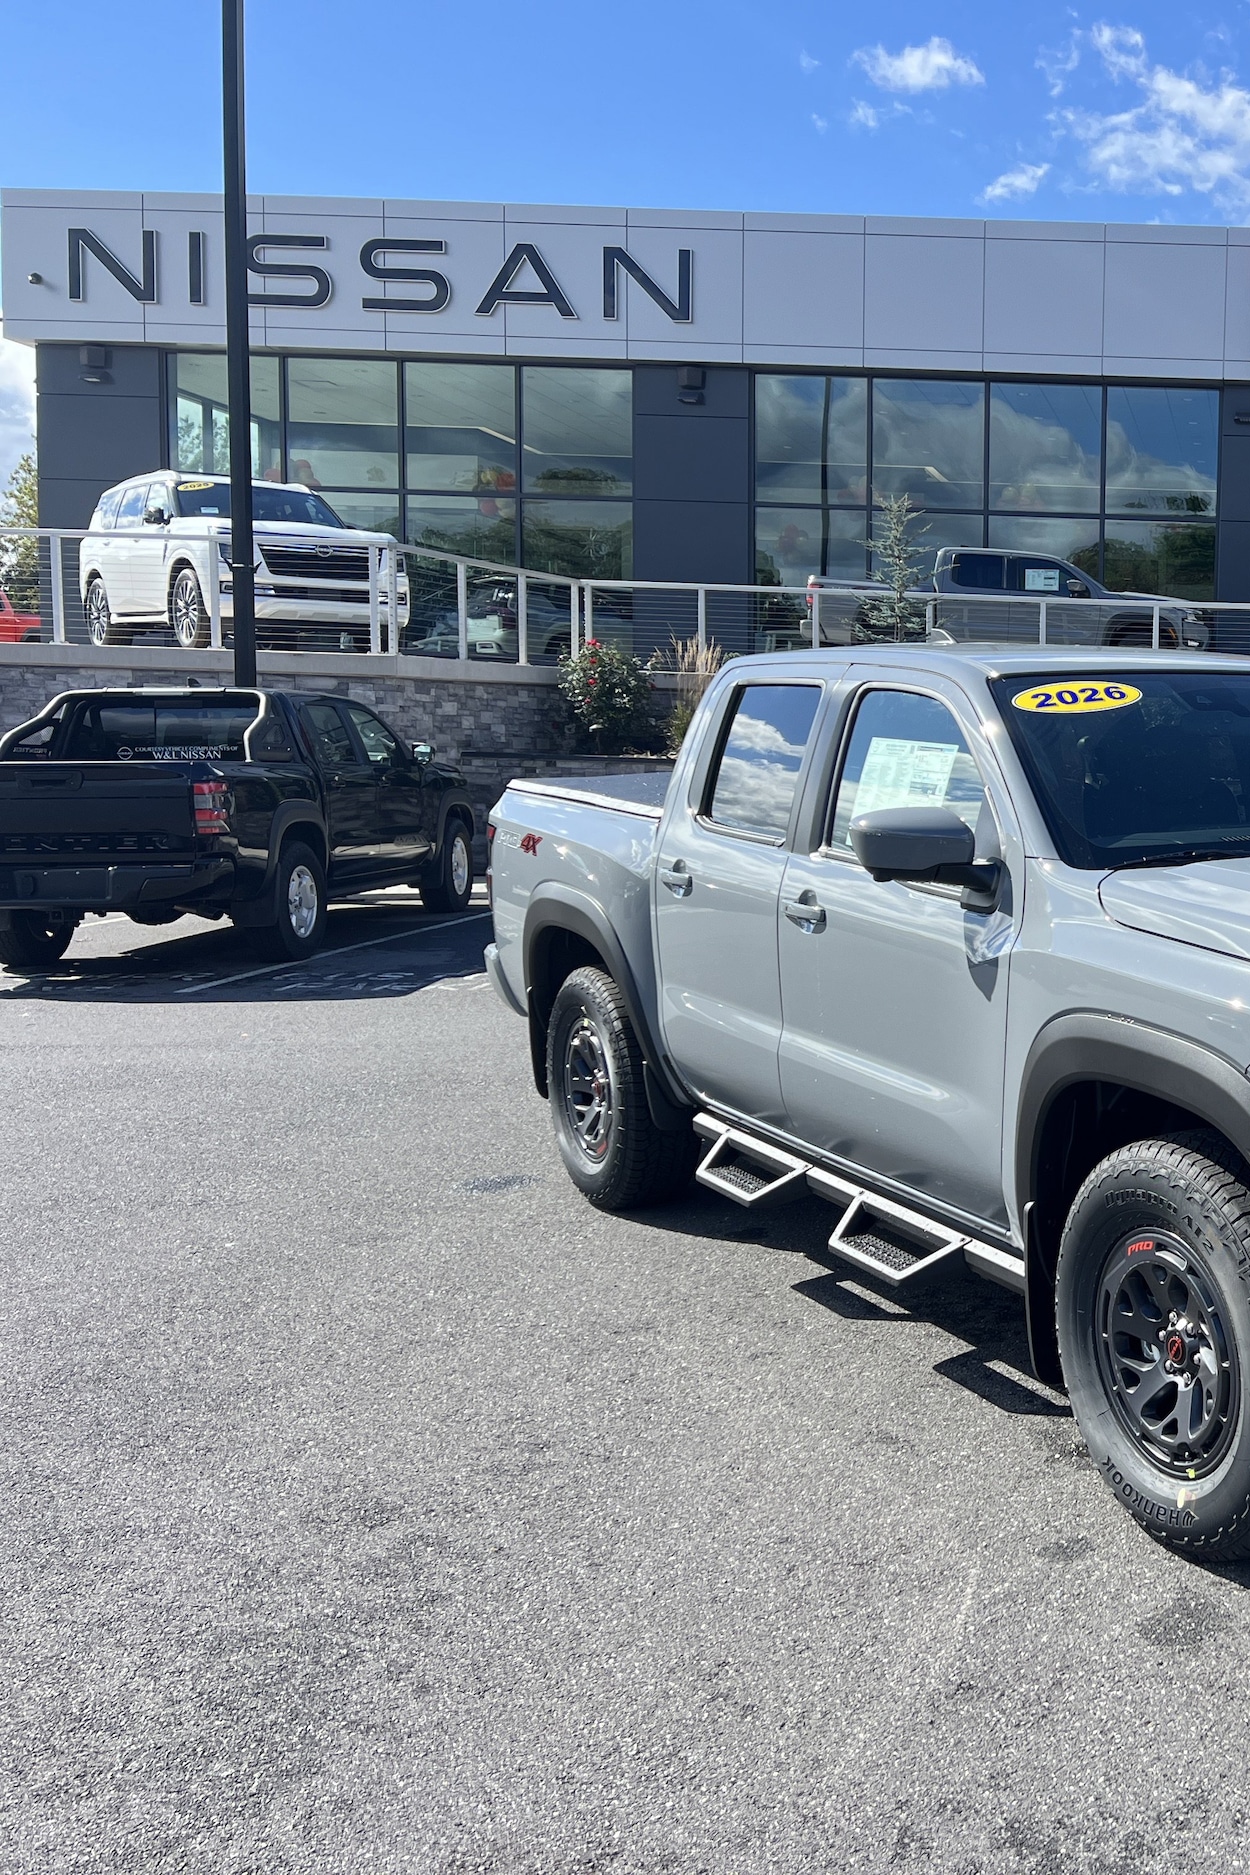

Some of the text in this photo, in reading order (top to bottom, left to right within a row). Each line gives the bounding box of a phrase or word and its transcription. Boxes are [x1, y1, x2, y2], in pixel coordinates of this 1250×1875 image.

[67, 226, 693, 324] NISSAN
[1031, 685, 1128, 709] 2026
[152, 750, 222, 760] W&L NISSAN
[1104, 1188, 1179, 1216] Dynapro
[1127, 1240, 1154, 1257] PRO
